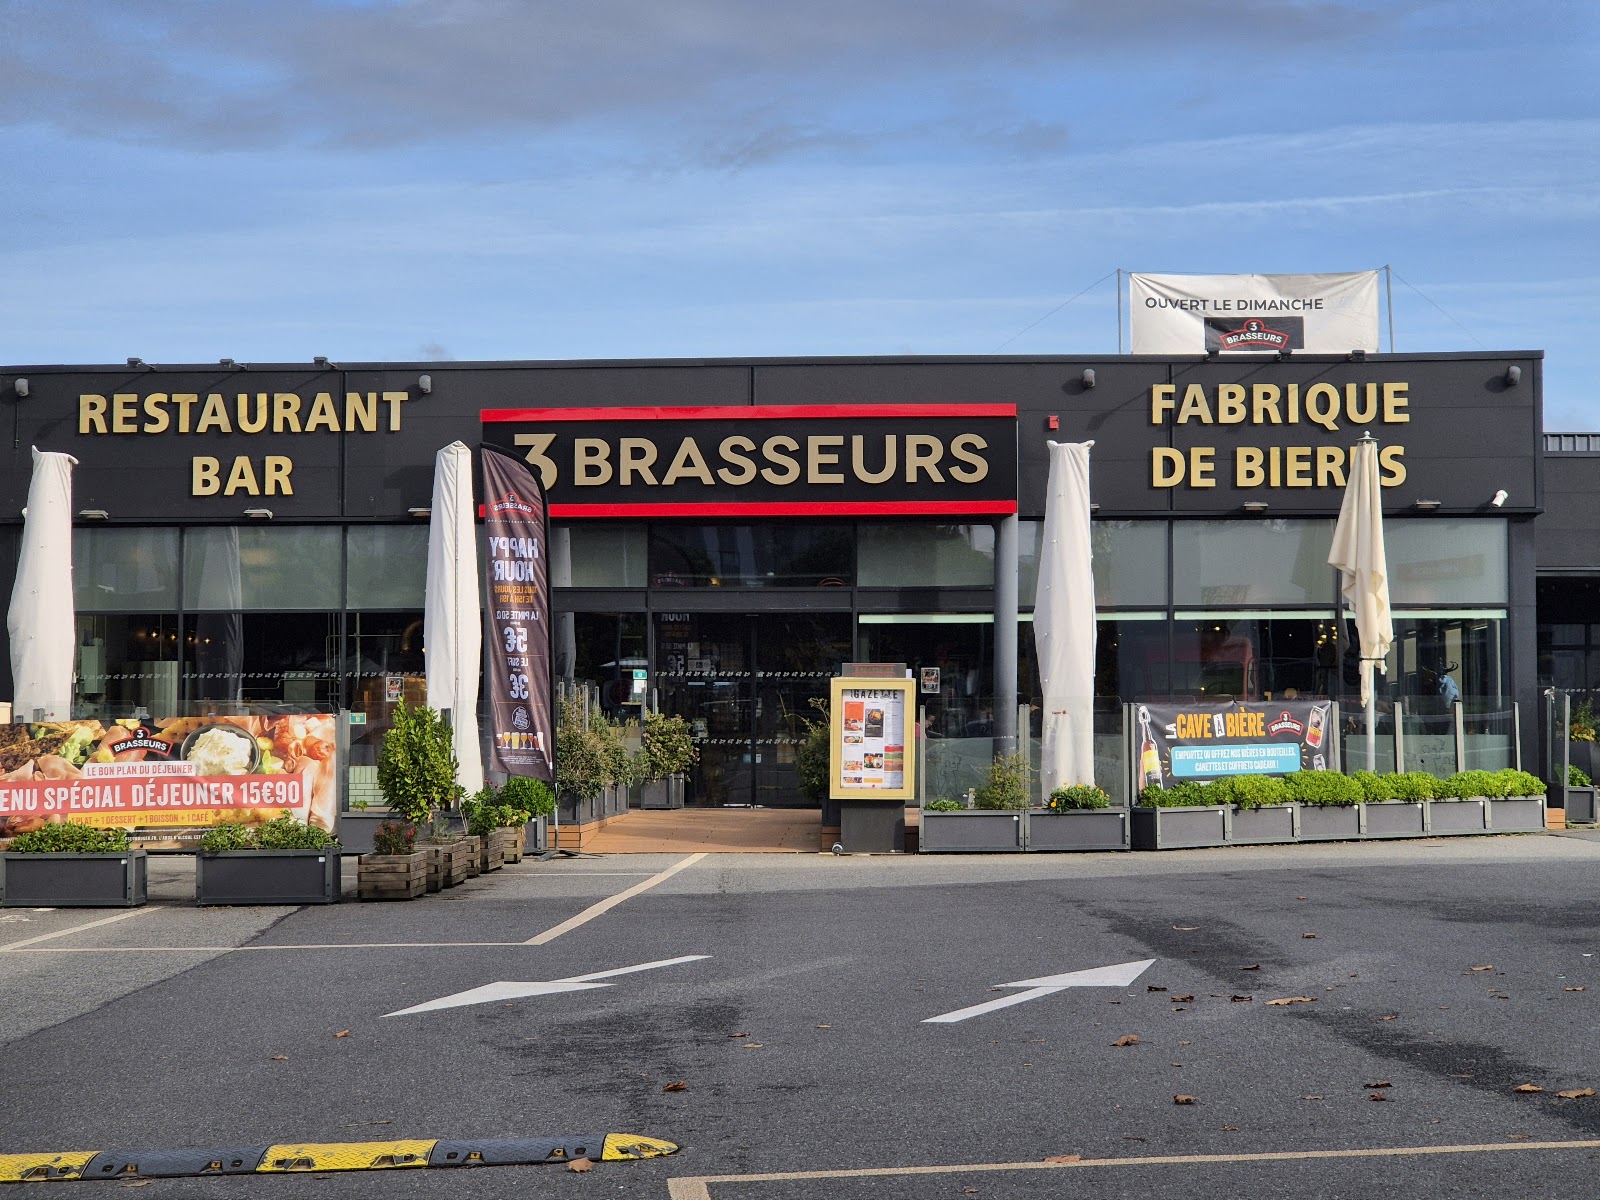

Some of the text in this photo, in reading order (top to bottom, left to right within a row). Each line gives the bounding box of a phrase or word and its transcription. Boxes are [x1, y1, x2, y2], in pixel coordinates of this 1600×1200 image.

[1145, 297, 1324, 311] OUVERT LE DIMANCHE
[1250, 321, 1258, 332] 3
[1226, 331, 1282, 345] BRASSEURS
[79, 391, 409, 434] RESTAURANT
[1152, 382, 1410, 431] FABRIQUE
[514, 432, 990, 491] 3 BRASSEURS
[1152, 445, 1407, 488] DE BIERS
[192, 455, 294, 496] BAR
[1177, 714, 1212, 738] CAVE
[1226, 706, 1266, 736] BIÈRE
[137, 730, 144, 738] 3
[113, 740, 168, 753] BRASSEURS
[1175, 749, 1203, 760] EMPORTEZ
[1259, 748, 1266, 757] EN
[87, 762, 193, 776] LE BON PLAN DU DÉJEUNER
[1221, 761, 1228, 770] ET
[44, 781, 125, 810] SPÉCIAL
[132, 778, 234, 807] DÉJEUNER
[240, 780, 300, 804] 15€90
[106, 815, 136, 824] DESSERT
[150, 814, 178, 823] BOISSON
[192, 812, 208, 822] CAFÉ
